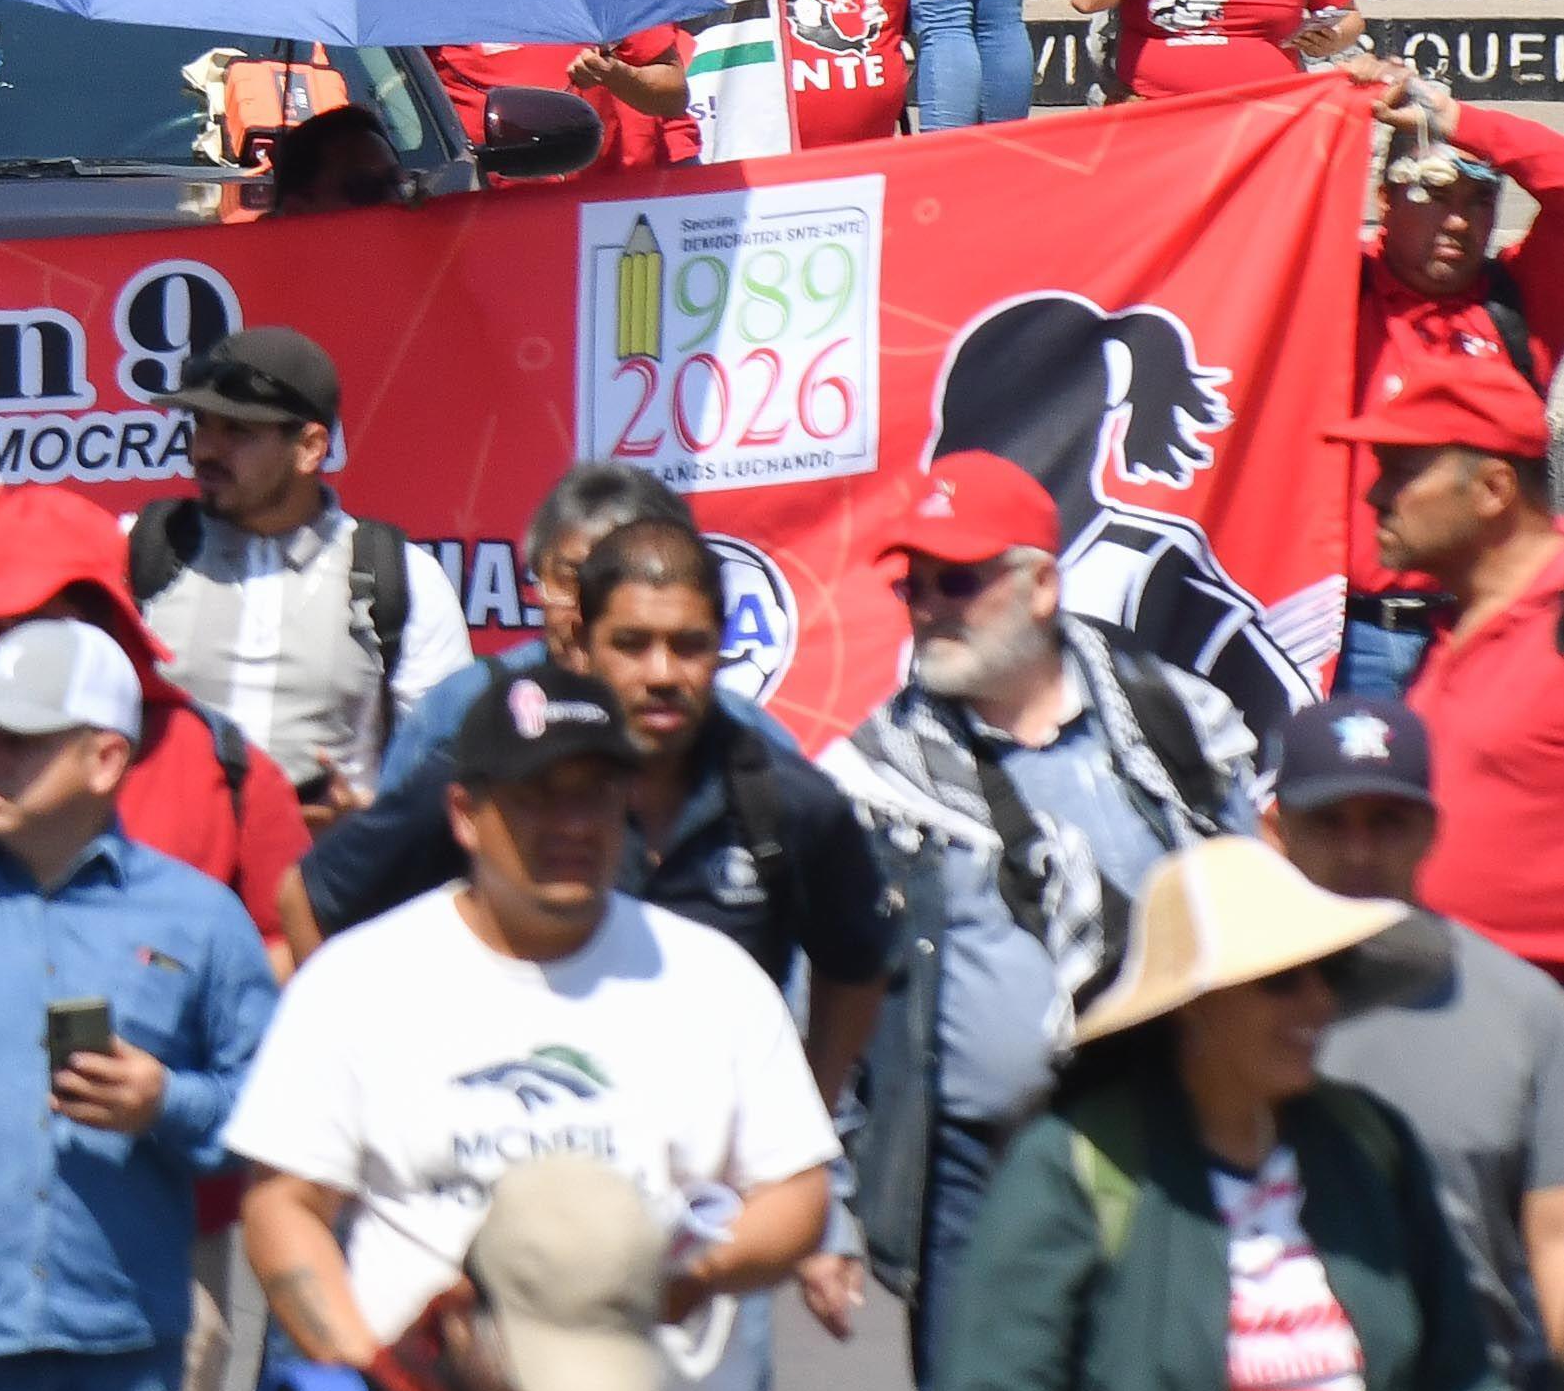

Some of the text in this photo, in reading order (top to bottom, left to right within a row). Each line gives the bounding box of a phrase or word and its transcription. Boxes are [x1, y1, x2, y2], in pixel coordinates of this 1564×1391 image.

[128, 273, 229, 396] 9
[611, 336, 859, 458] 2026
[723, 449, 835, 479] LUCHANDO
